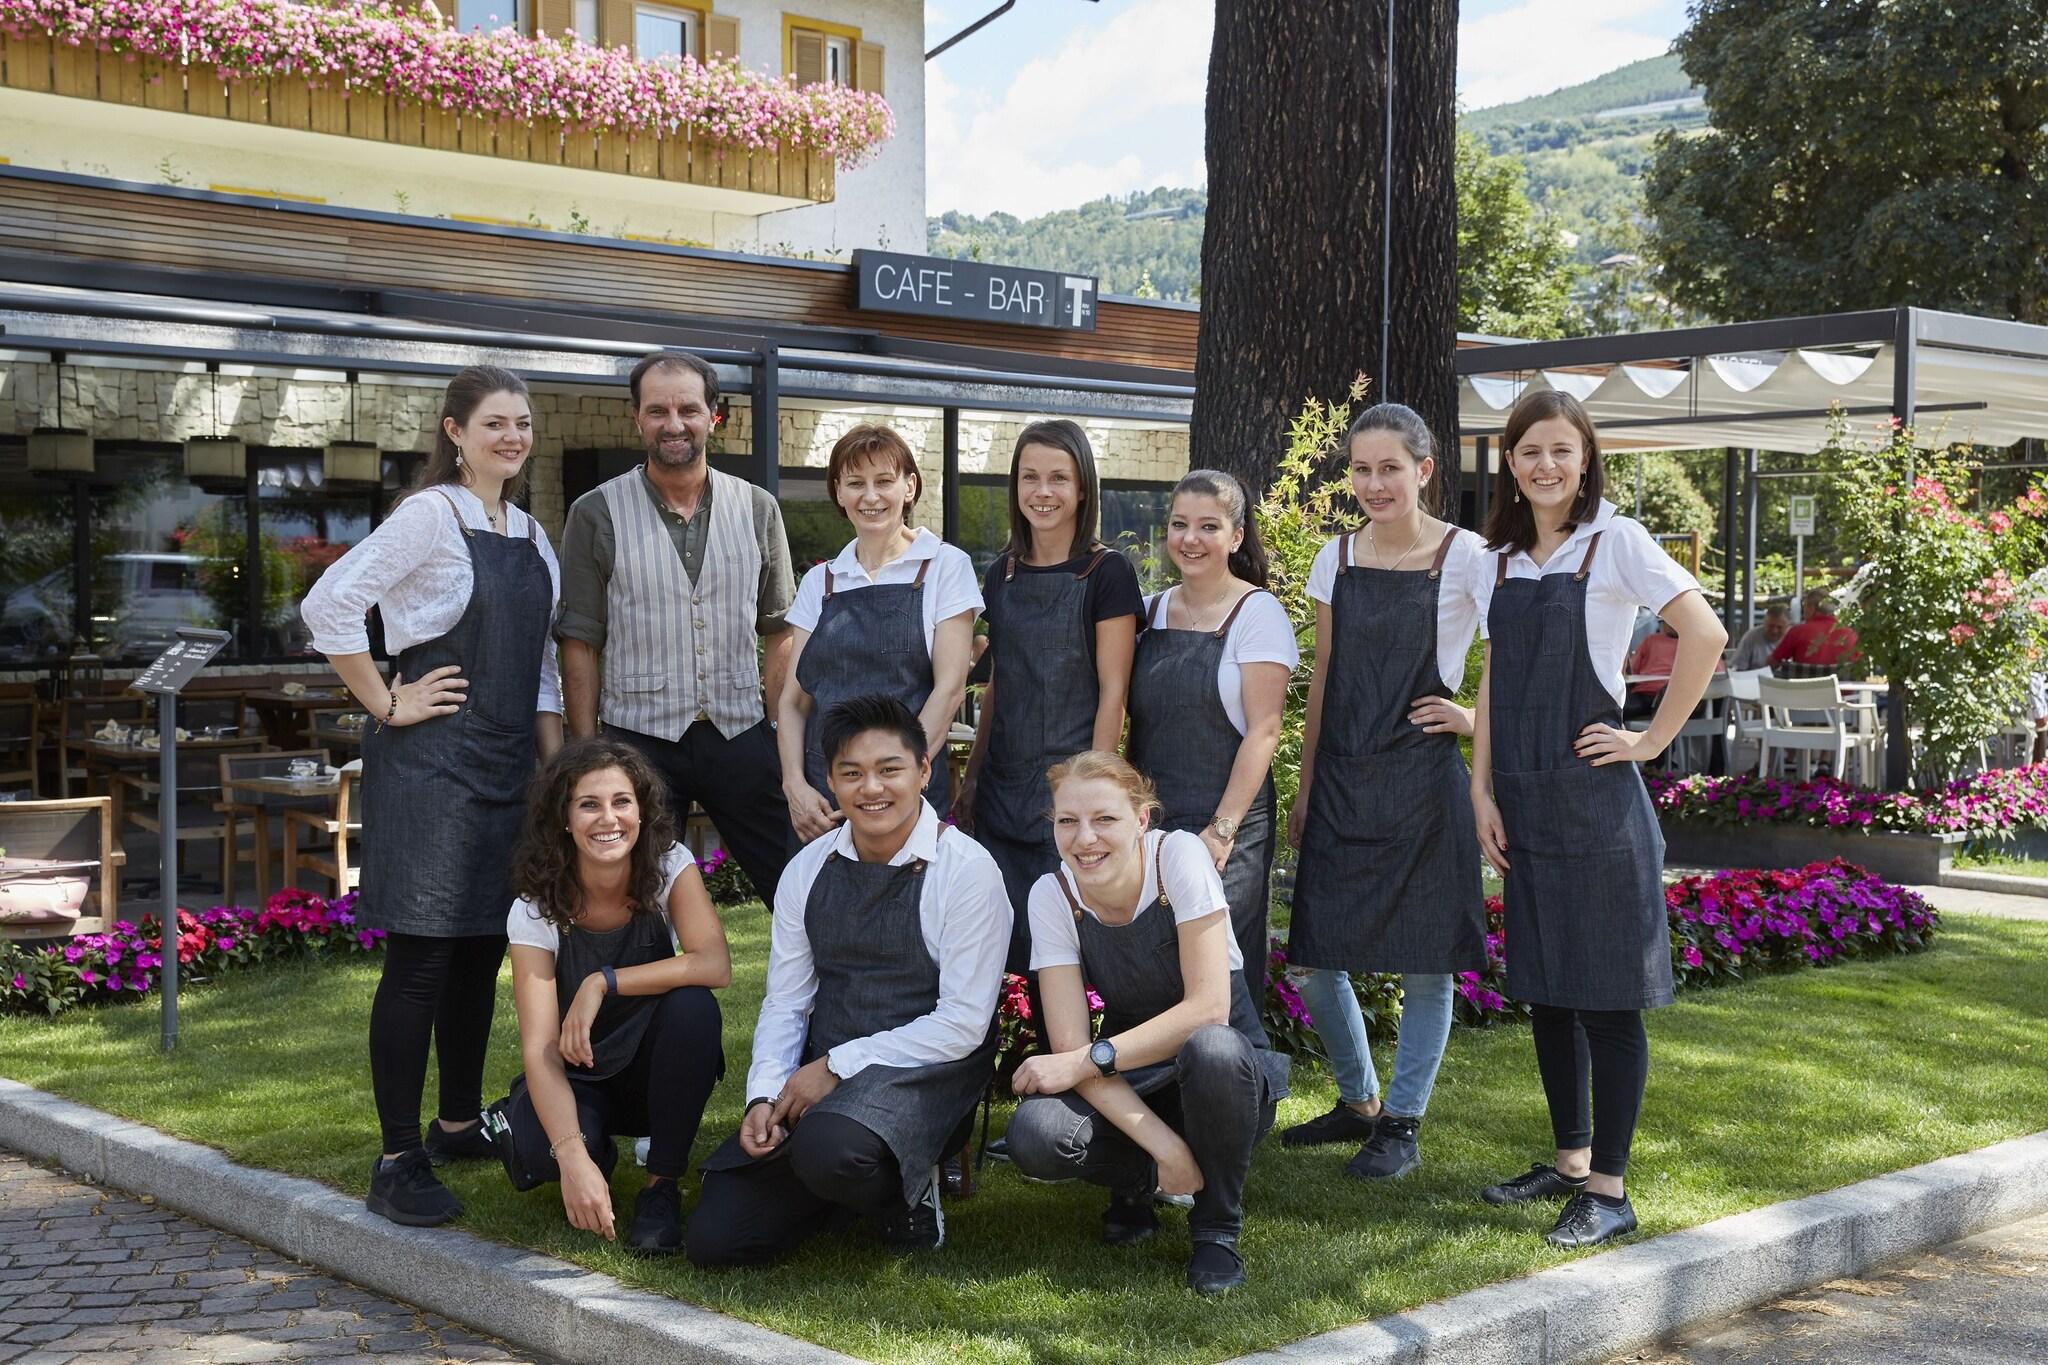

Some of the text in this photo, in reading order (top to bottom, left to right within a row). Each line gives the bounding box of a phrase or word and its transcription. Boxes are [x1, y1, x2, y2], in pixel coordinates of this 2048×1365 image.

[875, 264, 952, 305] CAFE
[989, 277, 1045, 314] BAR
[1065, 276, 1092, 327] T
